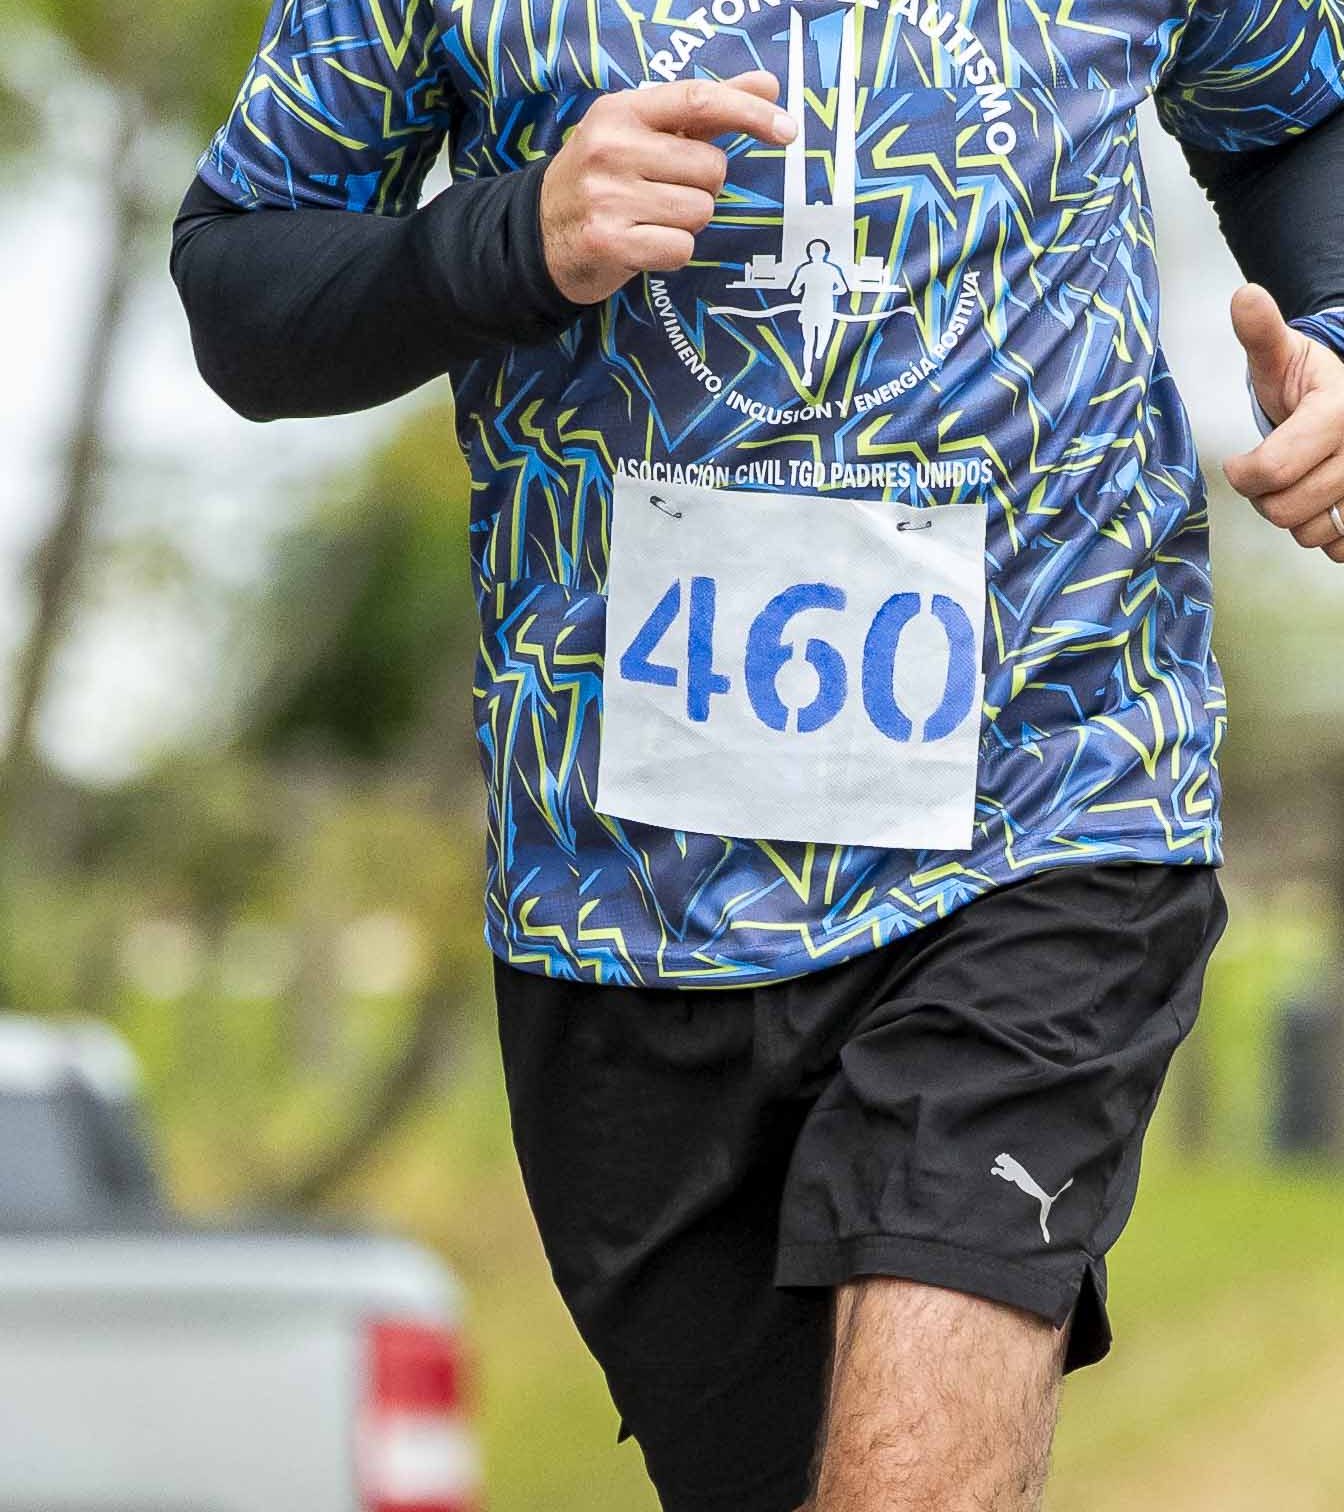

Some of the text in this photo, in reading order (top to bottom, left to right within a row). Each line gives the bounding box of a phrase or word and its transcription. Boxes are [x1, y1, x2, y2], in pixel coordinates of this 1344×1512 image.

[650, 270, 980, 425] MOVIMIENTO, INCLUSIÓN Y ENERGÍA POSITIVA
[616, 456, 993, 489] ASOCIACIÓN CIVIL TGD PADRES UNIDOS
[619, 576, 977, 744] 460
